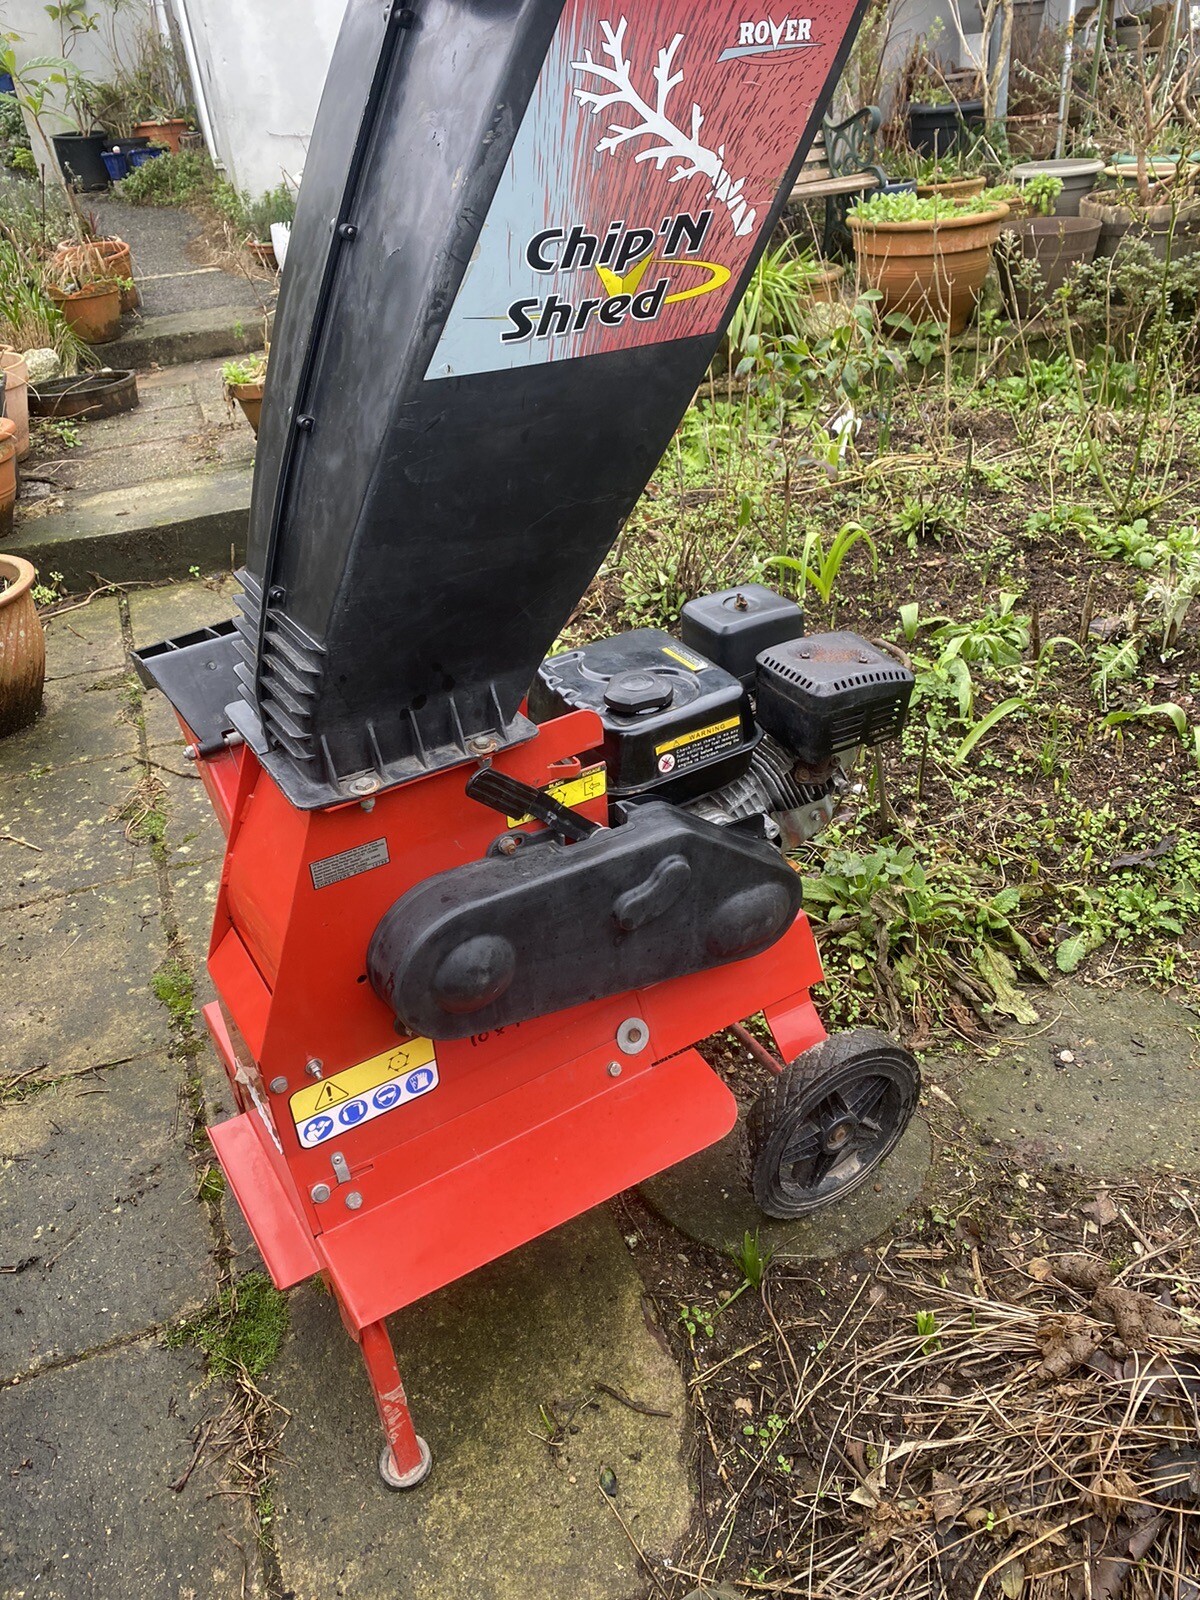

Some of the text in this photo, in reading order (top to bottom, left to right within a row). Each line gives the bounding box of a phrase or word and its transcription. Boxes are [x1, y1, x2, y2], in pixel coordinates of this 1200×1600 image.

[738, 14, 812, 50] ROVER
[500, 278, 669, 342] Shred
[689, 724, 726, 740] WARNING
[548, 780, 565, 789] BLADE
